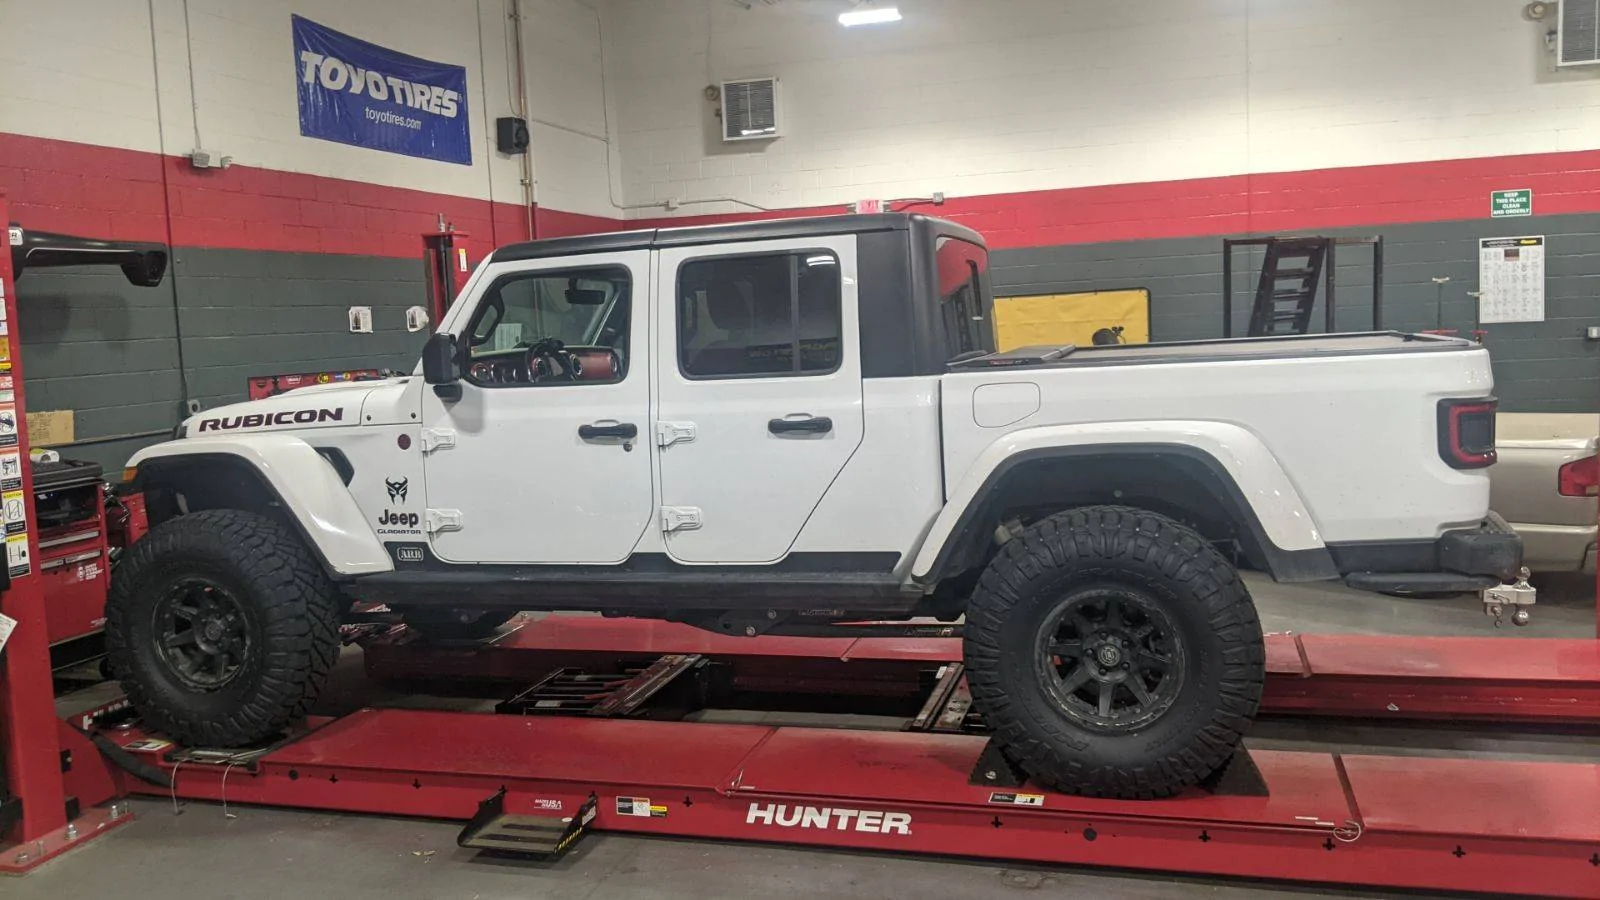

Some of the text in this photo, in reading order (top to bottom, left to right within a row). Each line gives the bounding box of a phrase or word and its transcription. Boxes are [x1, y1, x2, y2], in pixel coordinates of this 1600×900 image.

[364, 106, 422, 131] toyotires.com
[198, 407, 344, 432] RUBICON
[378, 508, 419, 528] Jeep
[400, 548, 422, 559] ARB
[746, 802, 912, 835] HUNTER
